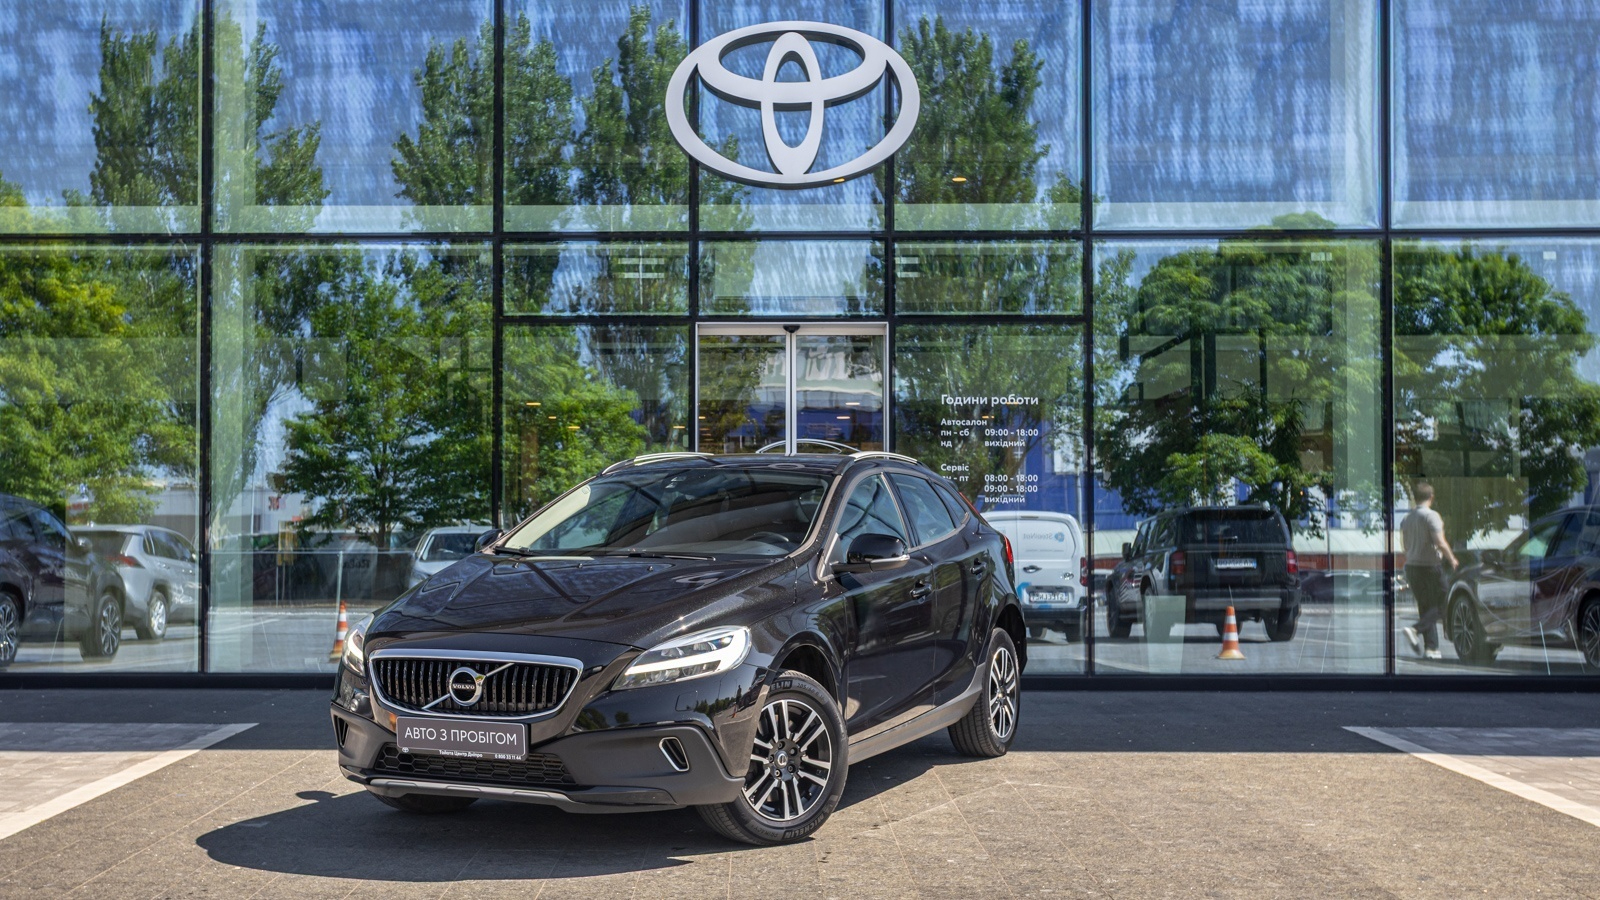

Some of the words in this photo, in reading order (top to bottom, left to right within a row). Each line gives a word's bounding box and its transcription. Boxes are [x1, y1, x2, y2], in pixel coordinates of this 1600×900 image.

[941, 394, 988, 407] Години
[991, 394, 1039, 407] роботи
[940, 418, 988, 426] Автосалон
[959, 428, 970, 437] сб
[984, 428, 1009, 437] 09:00
[1016, 428, 1039, 437] 18:00
[940, 440, 953, 448] нд
[984, 439, 1026, 448] вихідний
[940, 463, 970, 473] Сервіс
[984, 474, 1009, 482] 08:00
[1016, 474, 1039, 482] 18:00
[984, 485, 1008, 493] 09:00
[1015, 485, 1038, 493] 18:00
[984, 495, 1026, 503] вихідний
[770, 680, 791, 690] ELIN
[404, 726, 437, 740] АВТО
[439, 728, 448, 741] З
[450, 729, 517, 746] ПРОБІГОМ
[783, 814, 825, 839] MICHELIN
